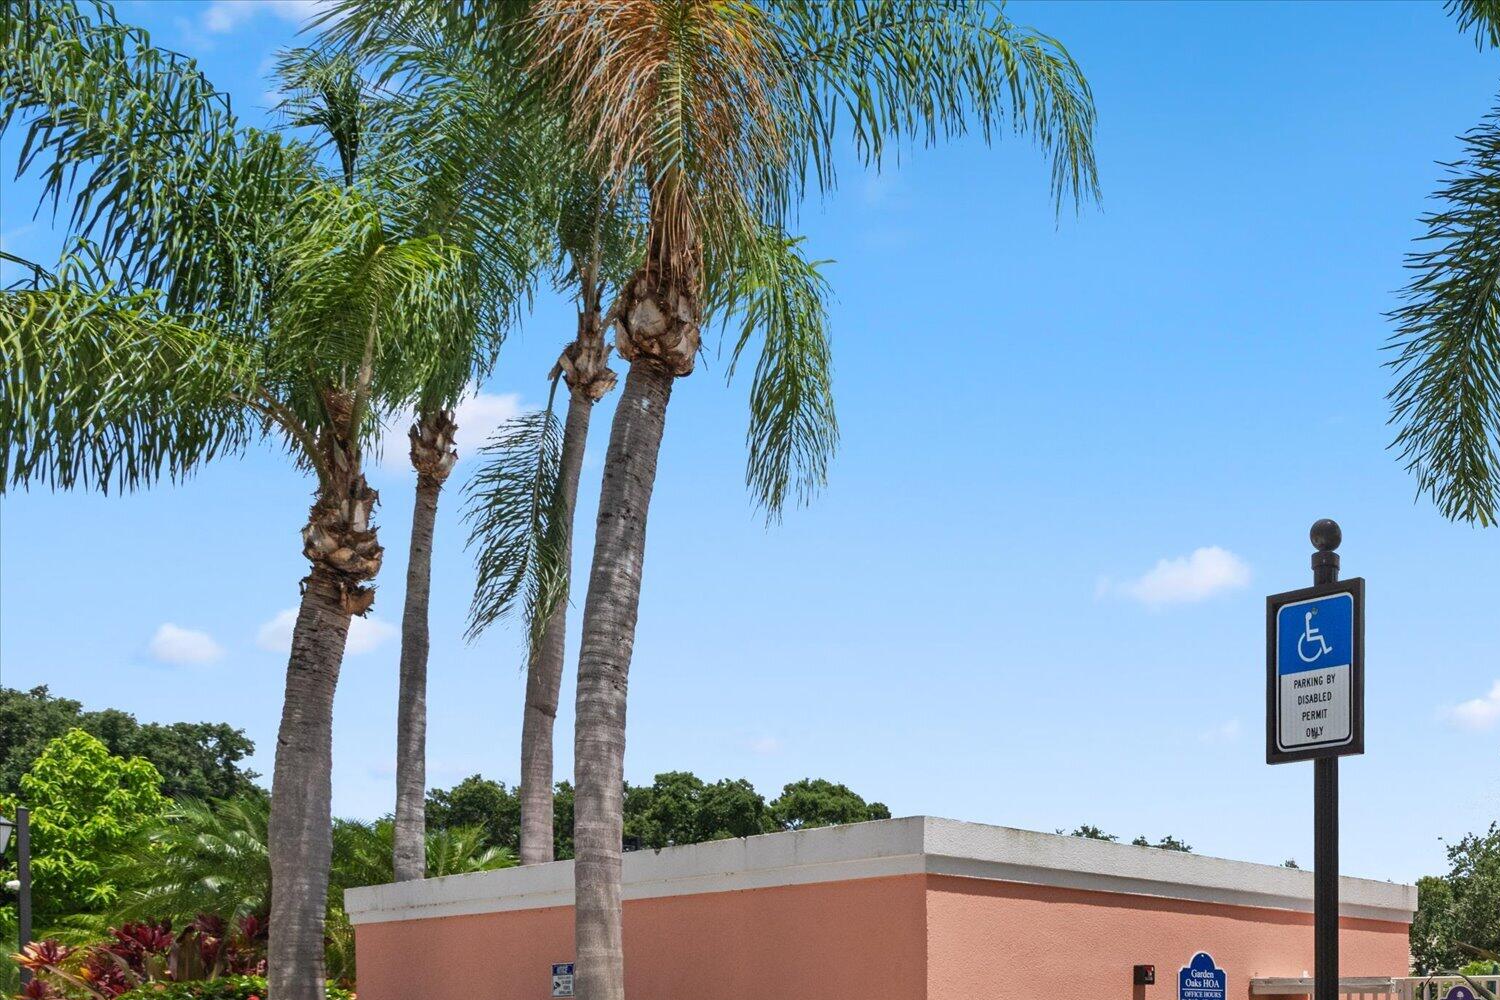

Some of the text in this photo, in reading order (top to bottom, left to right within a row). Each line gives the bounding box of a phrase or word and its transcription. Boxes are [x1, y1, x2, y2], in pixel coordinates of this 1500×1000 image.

[1293, 673, 1336, 689] PARKING BY
[1297, 691, 1332, 706] DISABLED
[1301, 708, 1328, 721] PERMIT
[1305, 726, 1324, 738] ONLY
[1191, 969, 1214, 978] Garden
[1185, 979, 1220, 988] Oaks HOA
